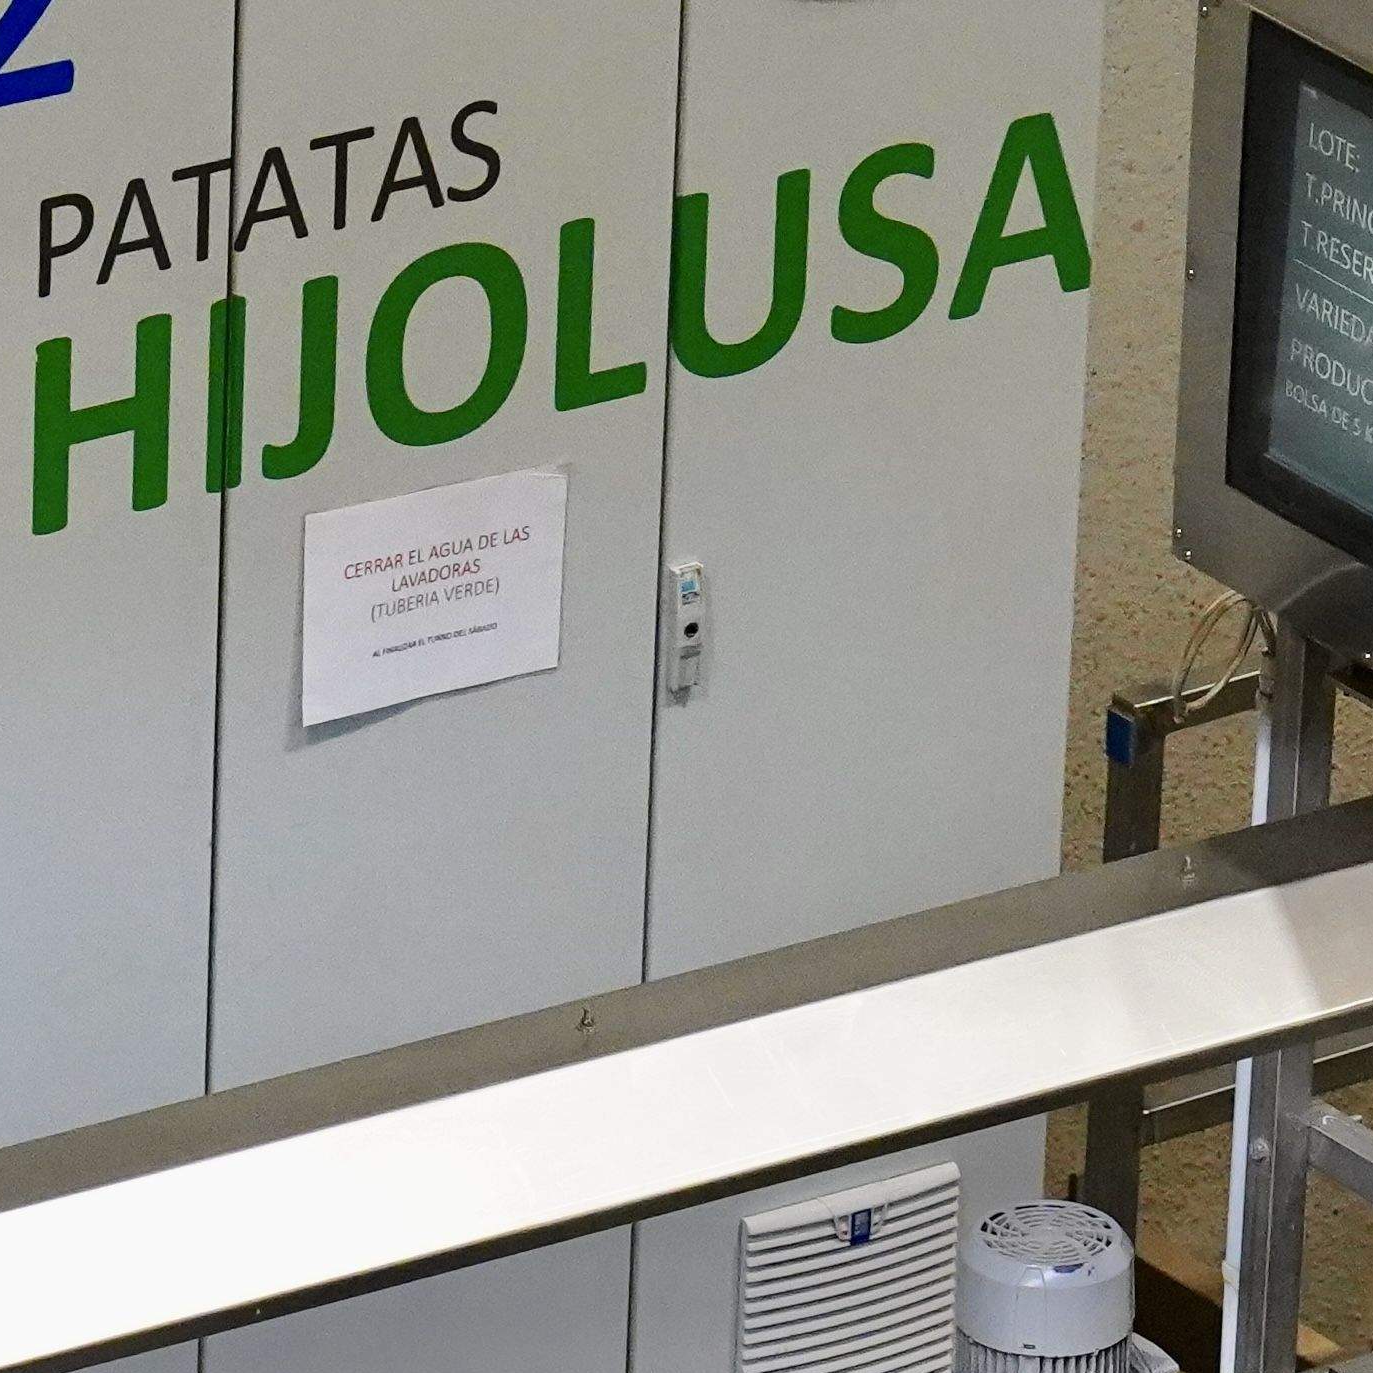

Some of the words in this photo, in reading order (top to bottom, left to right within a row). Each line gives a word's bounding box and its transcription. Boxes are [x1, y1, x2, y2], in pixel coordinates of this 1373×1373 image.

[1307, 122, 1360, 173] LOTE:
[37, 98, 503, 299] PATATAS
[31, 111, 1093, 539] HIJOLUSA
[1284, 379, 1328, 418] BOLSA
[1331, 406, 1350, 431] DE
[343, 553, 404, 580] CERRAR
[408, 549, 425, 567] EL
[428, 537, 474, 561] AGUA
[478, 531, 498, 550] DE
[503, 525, 531, 545] LAS
[391, 558, 481, 592] LAVADORAS
[444, 576, 500, 602] VERDE)
